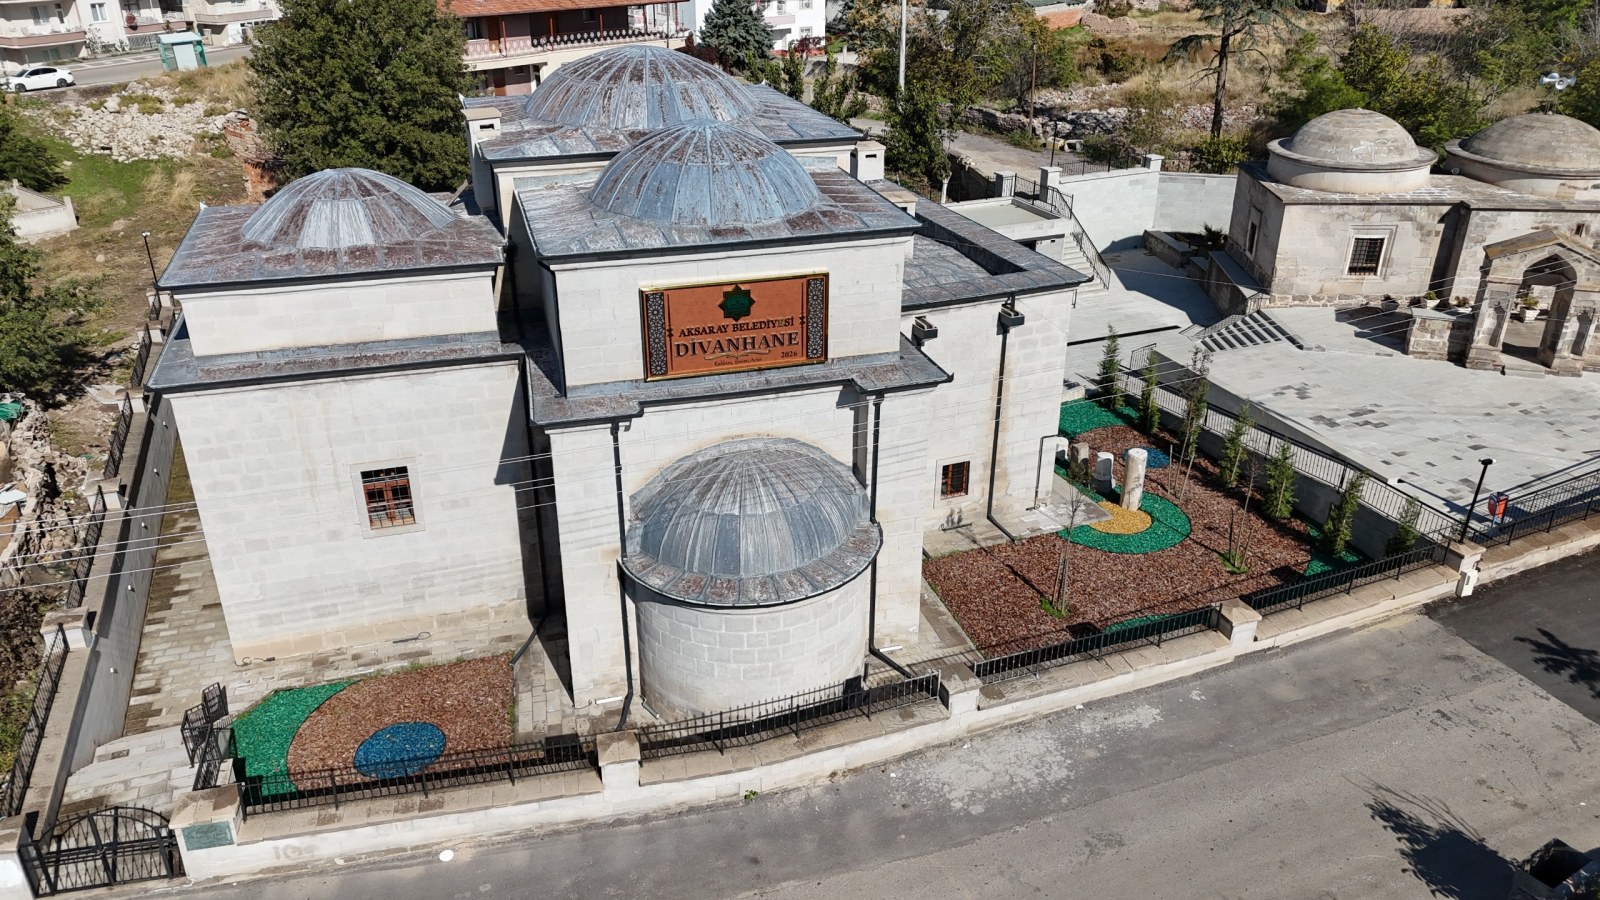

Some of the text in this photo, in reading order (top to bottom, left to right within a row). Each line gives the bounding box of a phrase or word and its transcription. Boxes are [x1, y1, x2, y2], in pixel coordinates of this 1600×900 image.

[679, 316, 794, 337] AKSARAY BELEDİYESİ
[674, 332, 799, 357] DİVANHANE
[781, 350, 798, 358] 2026
